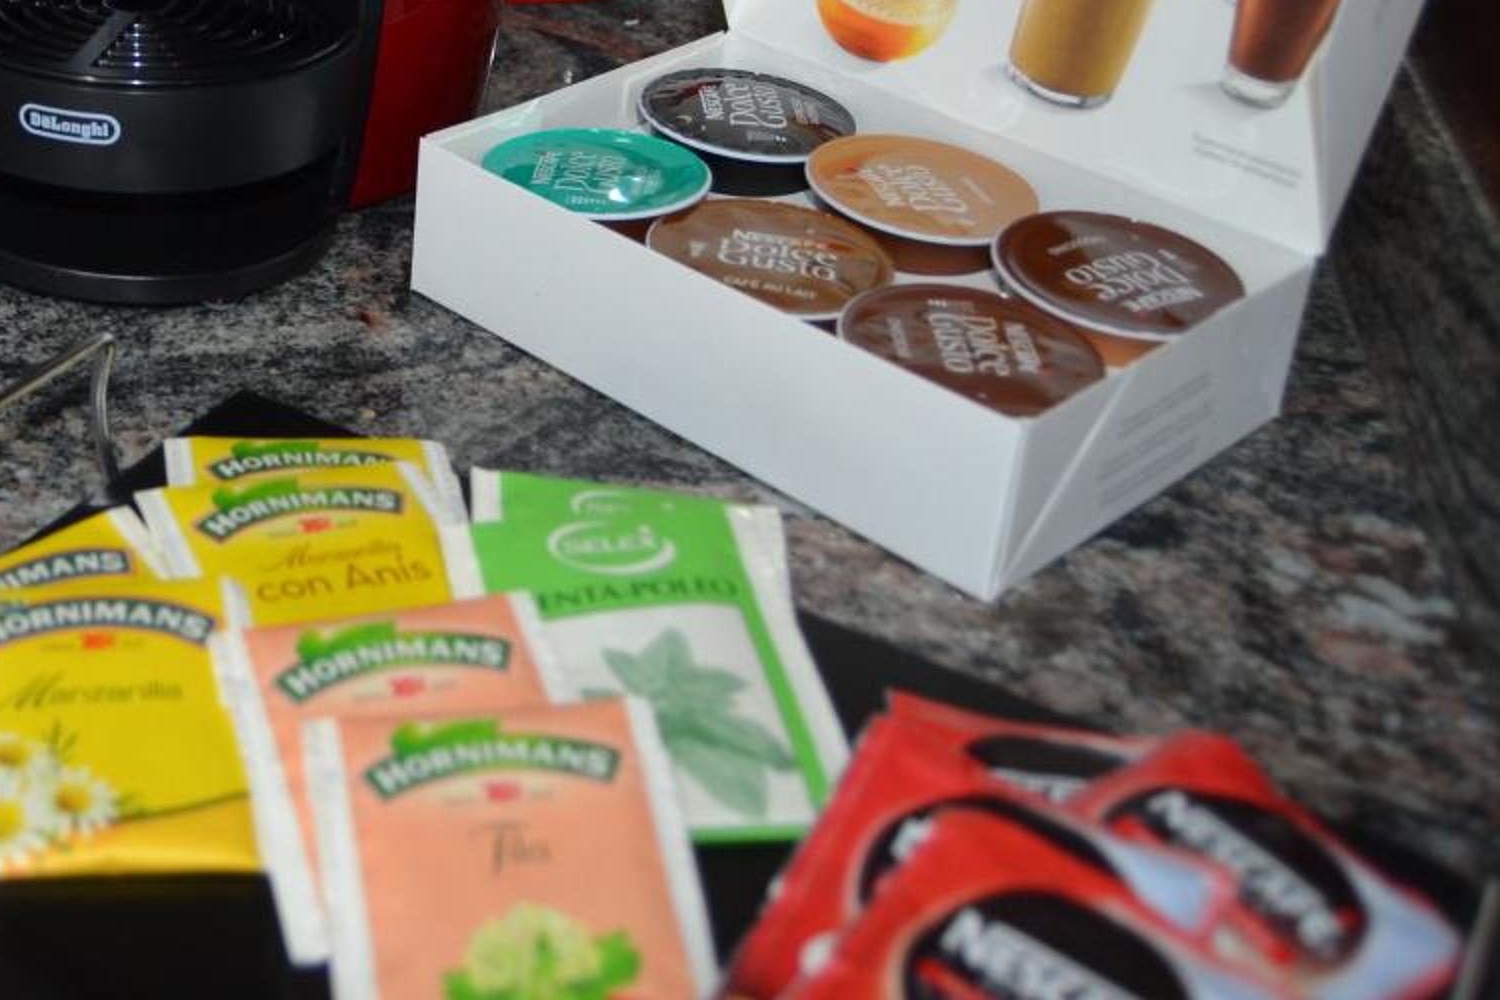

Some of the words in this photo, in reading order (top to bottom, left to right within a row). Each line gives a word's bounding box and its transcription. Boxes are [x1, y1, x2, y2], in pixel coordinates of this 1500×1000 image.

[29, 111, 109, 139] DeLonghi
[717, 251, 837, 281] Gusto
[204, 490, 396, 536] HORNIMANS
[256, 576, 334, 603] con
[284, 639, 503, 695] HORNIMANS
[375, 740, 613, 793] HORNIMANS
